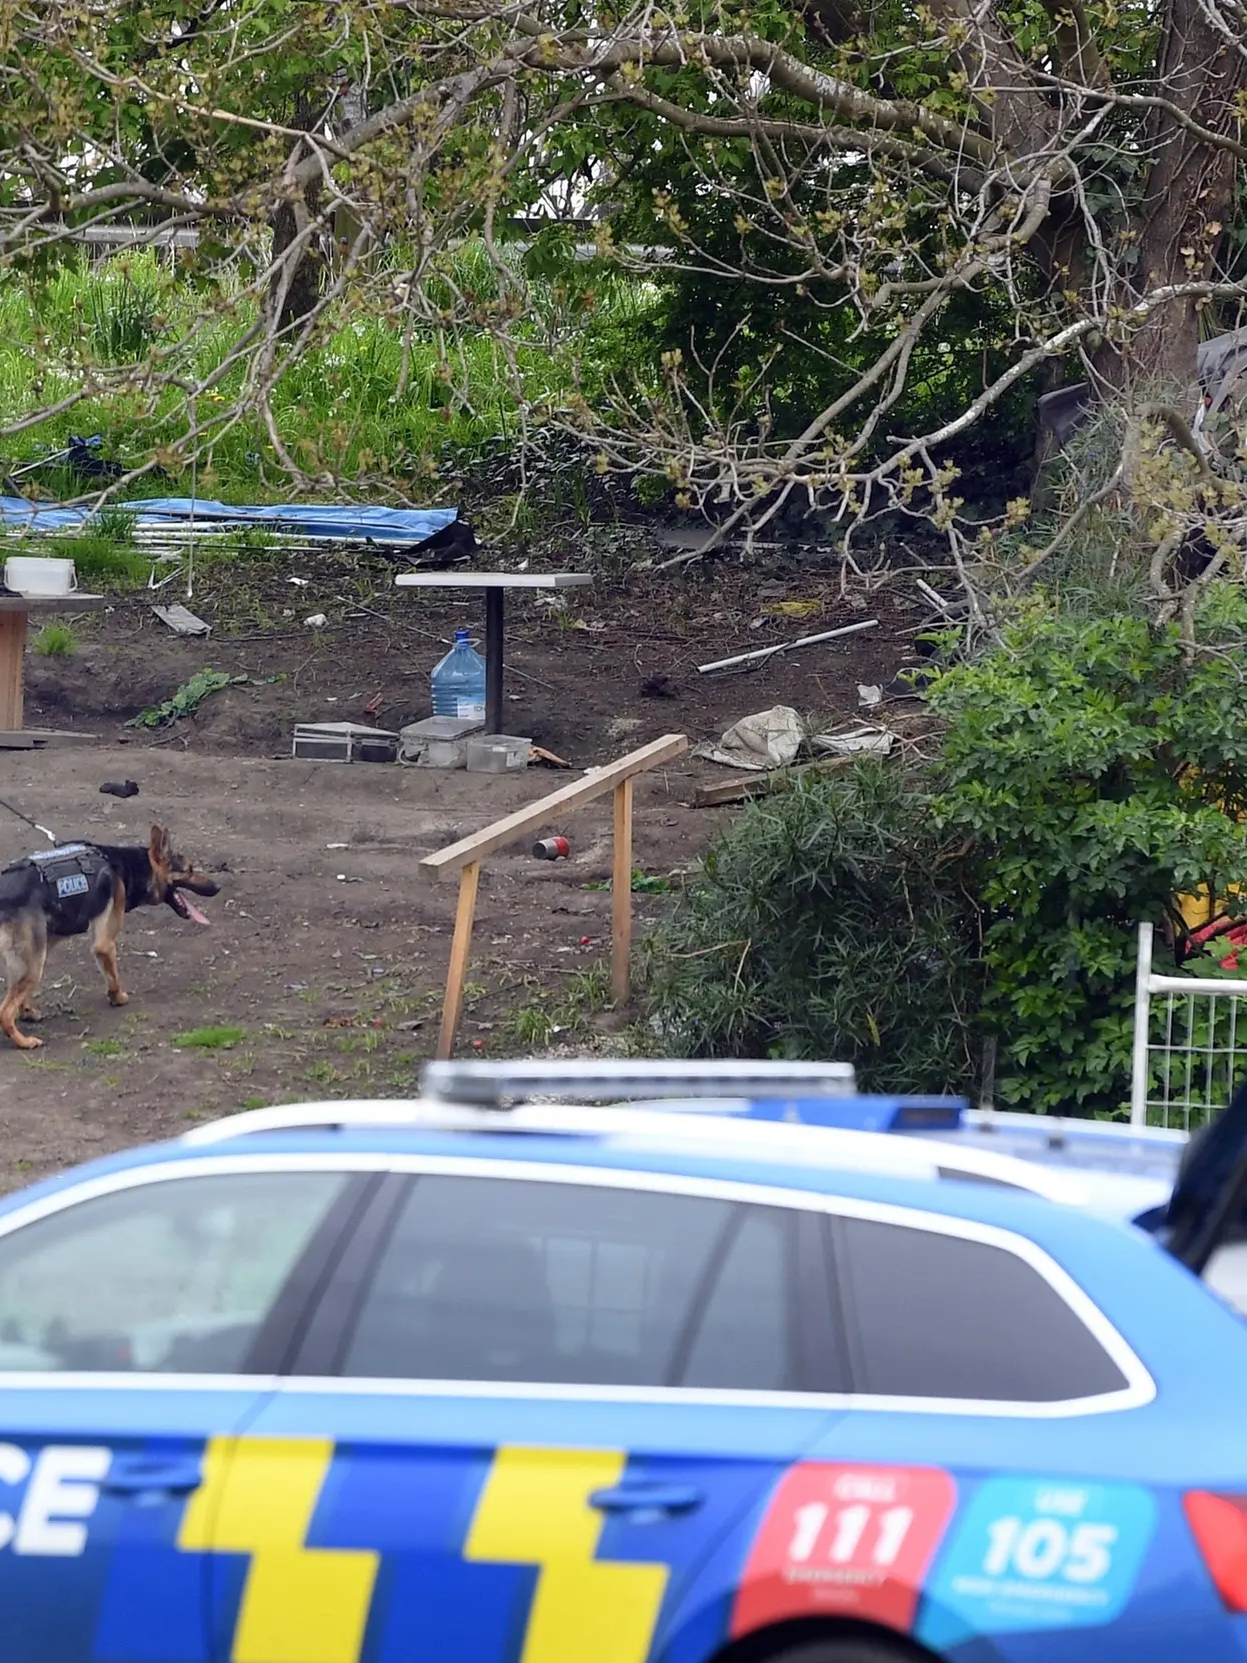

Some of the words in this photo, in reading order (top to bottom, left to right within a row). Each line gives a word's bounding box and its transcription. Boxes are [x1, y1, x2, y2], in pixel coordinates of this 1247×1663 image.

[59, 876, 88, 894] POLICE
[788, 1502, 914, 1565] 111
[983, 1516, 1118, 1583] 105
